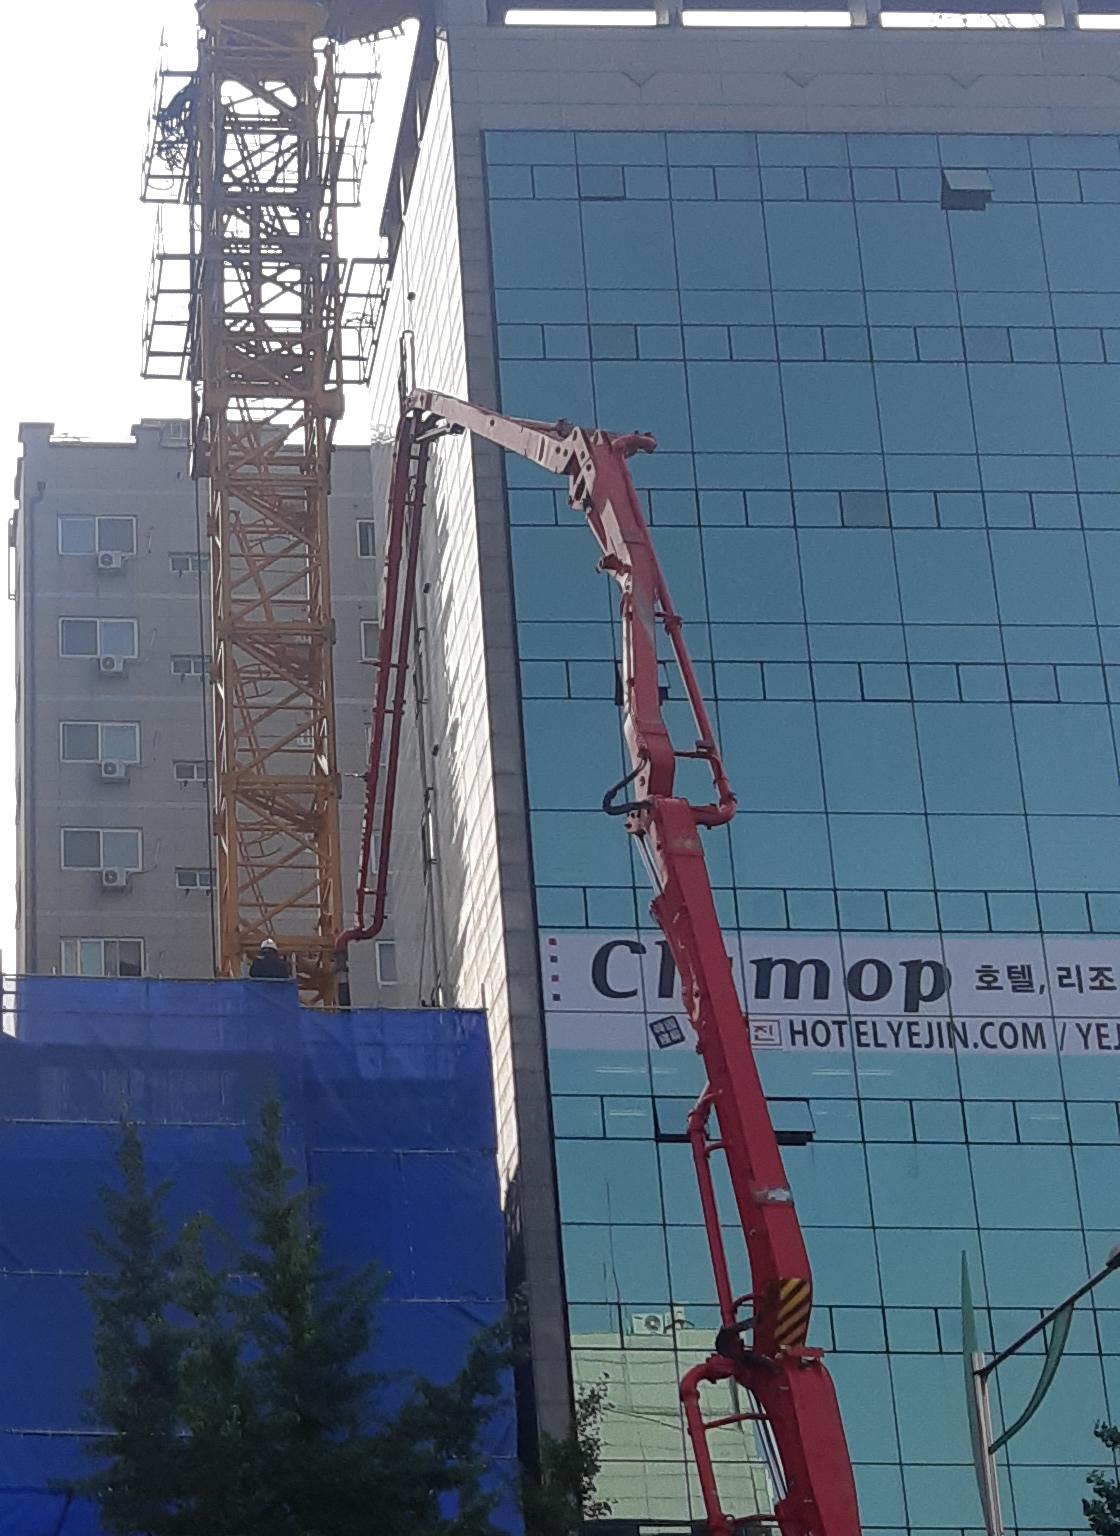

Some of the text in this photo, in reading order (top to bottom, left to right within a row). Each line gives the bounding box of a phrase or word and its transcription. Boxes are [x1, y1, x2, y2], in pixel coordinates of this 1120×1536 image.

[590, 939, 952, 1013] Cmop
[974, 963, 1046, 995] 호텔,
[788, 1019, 1047, 1051] HOTELYEJIN.COM
